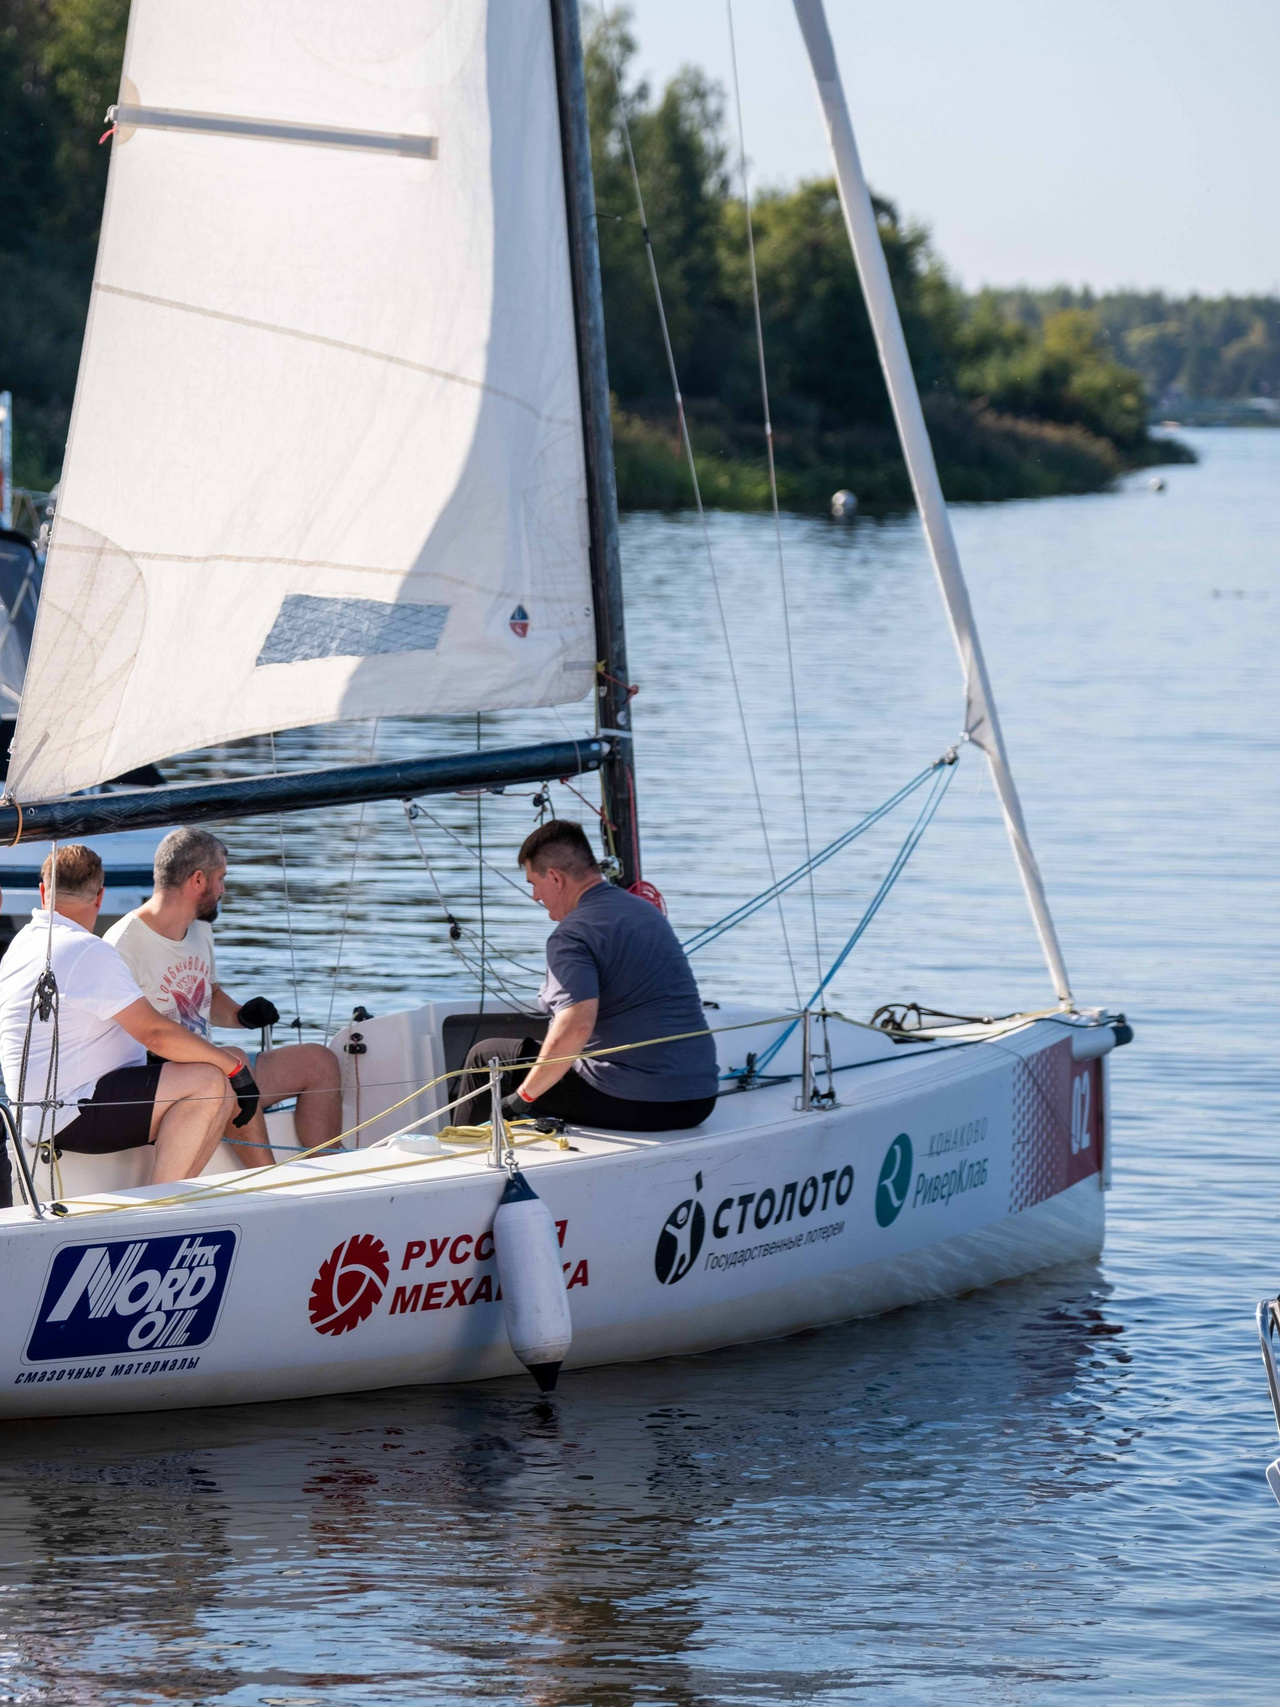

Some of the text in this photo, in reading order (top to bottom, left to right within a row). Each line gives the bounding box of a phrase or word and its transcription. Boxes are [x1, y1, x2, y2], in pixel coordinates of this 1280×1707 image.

[156, 966, 177, 1003] LONG
[928, 1116, 989, 1159] КОНАКОВО
[712, 1164, 855, 1239] СТОЛОТО
[912, 1157, 990, 1209] РиверКлаб
[401, 1219, 569, 1271] РУССЯ
[704, 1220, 846, 1272] Государственные лотереи
[389, 1259, 589, 1316] МЕХАА
[127, 1308, 199, 1350] OIL
[14, 1356, 201, 1385] смазочные материалы
